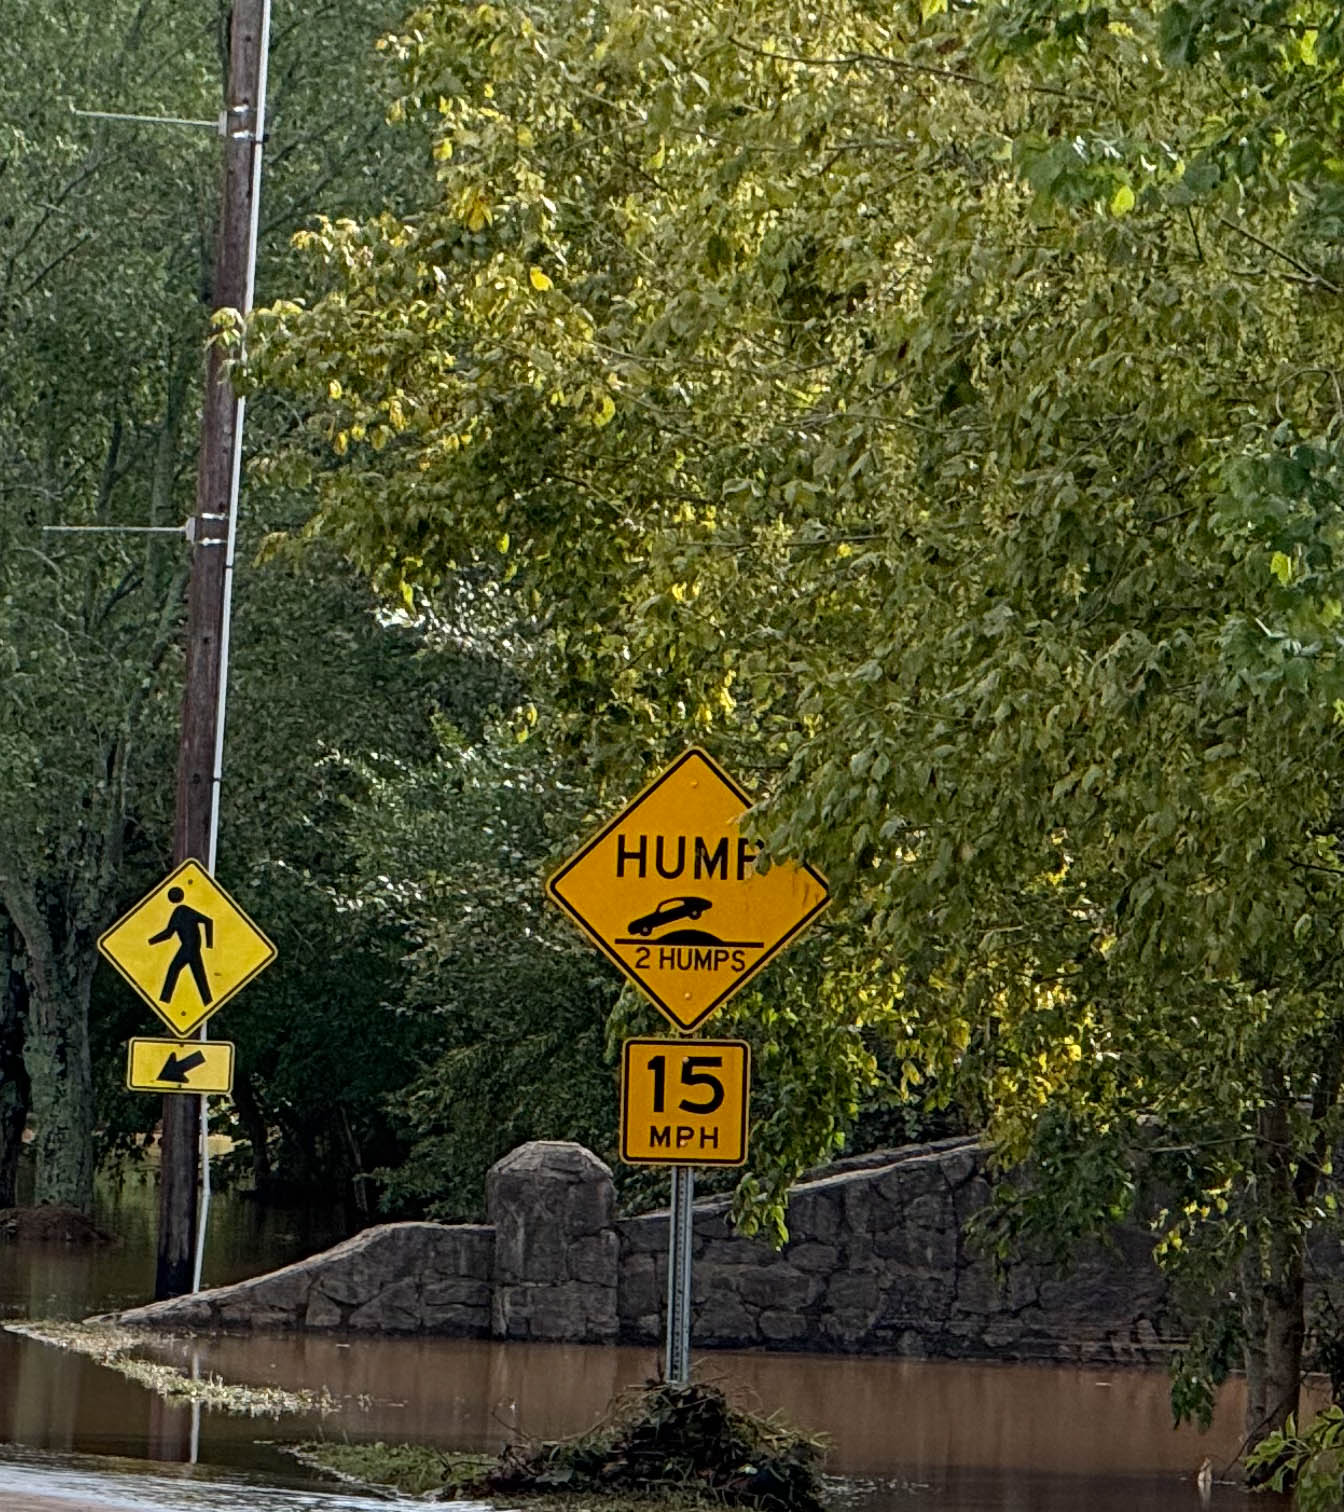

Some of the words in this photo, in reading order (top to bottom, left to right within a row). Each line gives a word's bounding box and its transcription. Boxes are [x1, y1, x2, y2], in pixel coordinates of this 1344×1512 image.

[635, 946, 651, 969] 2
[659, 947, 746, 973] HUMPS
[647, 1055, 725, 1115] 15
[649, 1125, 719, 1149] MPH
